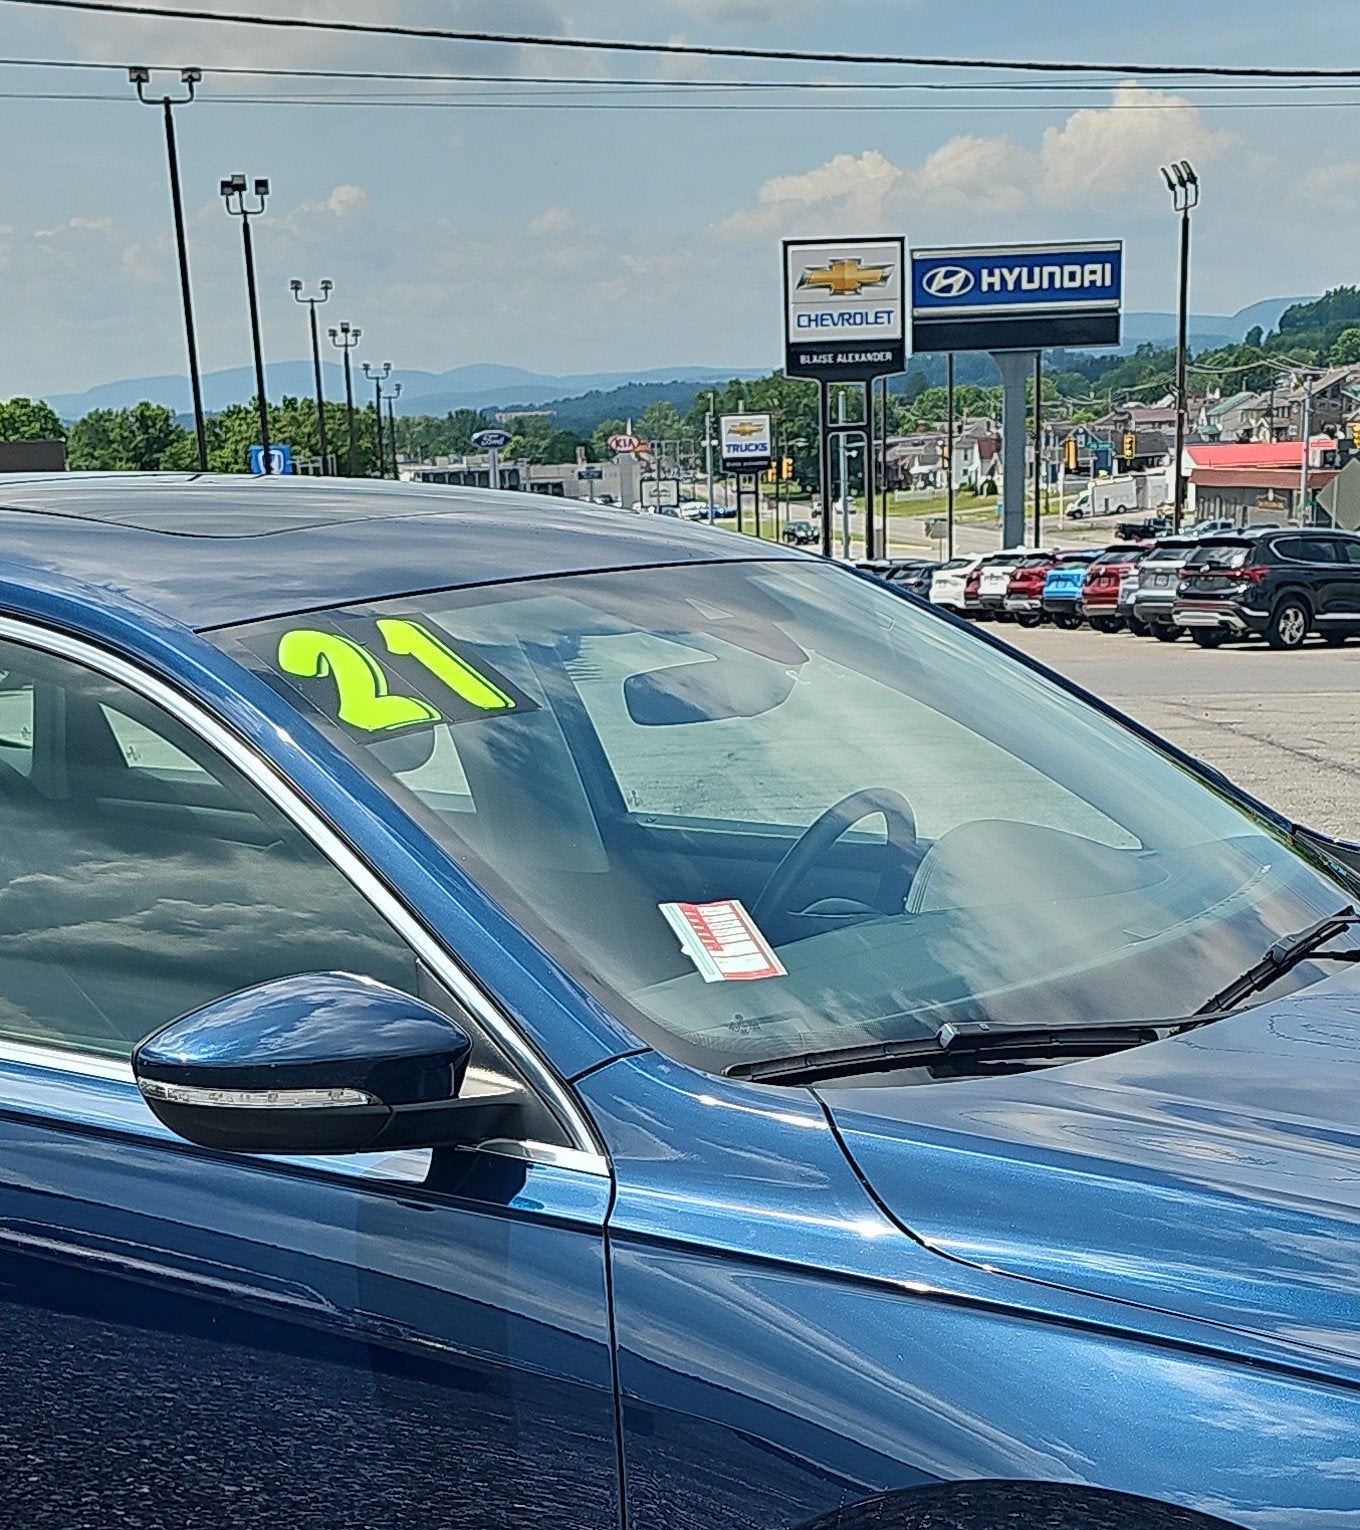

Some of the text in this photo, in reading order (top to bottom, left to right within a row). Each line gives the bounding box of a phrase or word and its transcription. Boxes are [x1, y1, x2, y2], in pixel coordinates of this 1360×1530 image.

[980, 262, 1112, 292] HYUNDAI
[796, 309, 895, 328] CHEVROLET
[799, 350, 893, 365] BLAISE ALEXANDER
[614, 438, 635, 450] KIA
[725, 441, 769, 454] TRUCKS
[276, 617, 518, 733] 21
